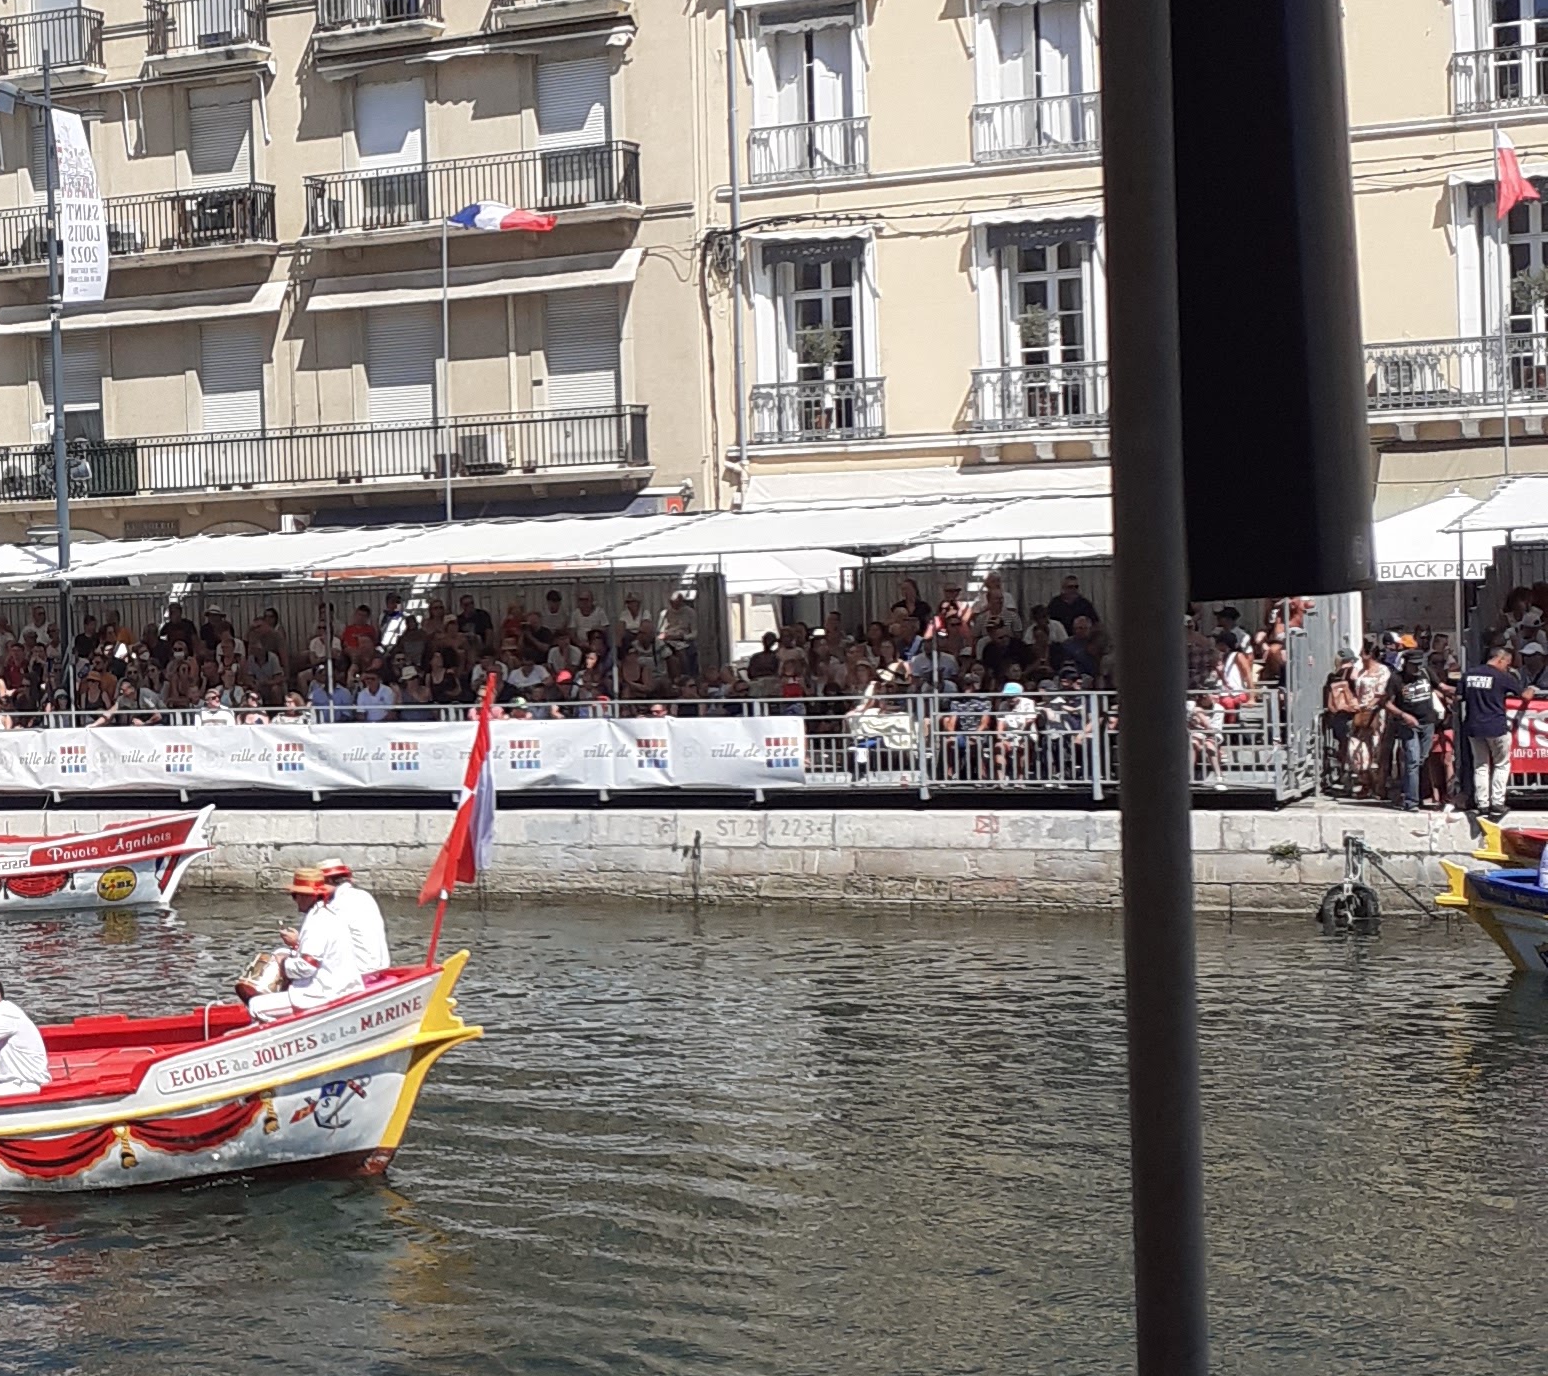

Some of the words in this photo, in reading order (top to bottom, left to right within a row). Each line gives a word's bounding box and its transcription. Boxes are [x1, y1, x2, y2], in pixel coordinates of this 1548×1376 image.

[1380, 564, 1438, 579] BLACK
[121, 750, 144, 763] ville
[147, 750, 161, 763] de
[230, 748, 253, 762] ville
[258, 748, 272, 762] de
[342, 748, 368, 762] ville
[371, 747, 386, 761] de
[493, 745, 504, 759] de
[583, 744, 613, 758] ville
[616, 744, 631, 758] de
[711, 743, 740, 758] ville
[743, 743, 760, 757] de
[19, 752, 41, 765] ville
[44, 753, 56, 765] de
[47, 846, 99, 861] Pavois
[107, 832, 172, 853] Agathois
[169, 1059, 230, 1087] ECOLE
[233, 1059, 249, 1073] de
[252, 1034, 319, 1067] JOUTES
[321, 1031, 337, 1045] de
[360, 996, 423, 1032] MARINE
